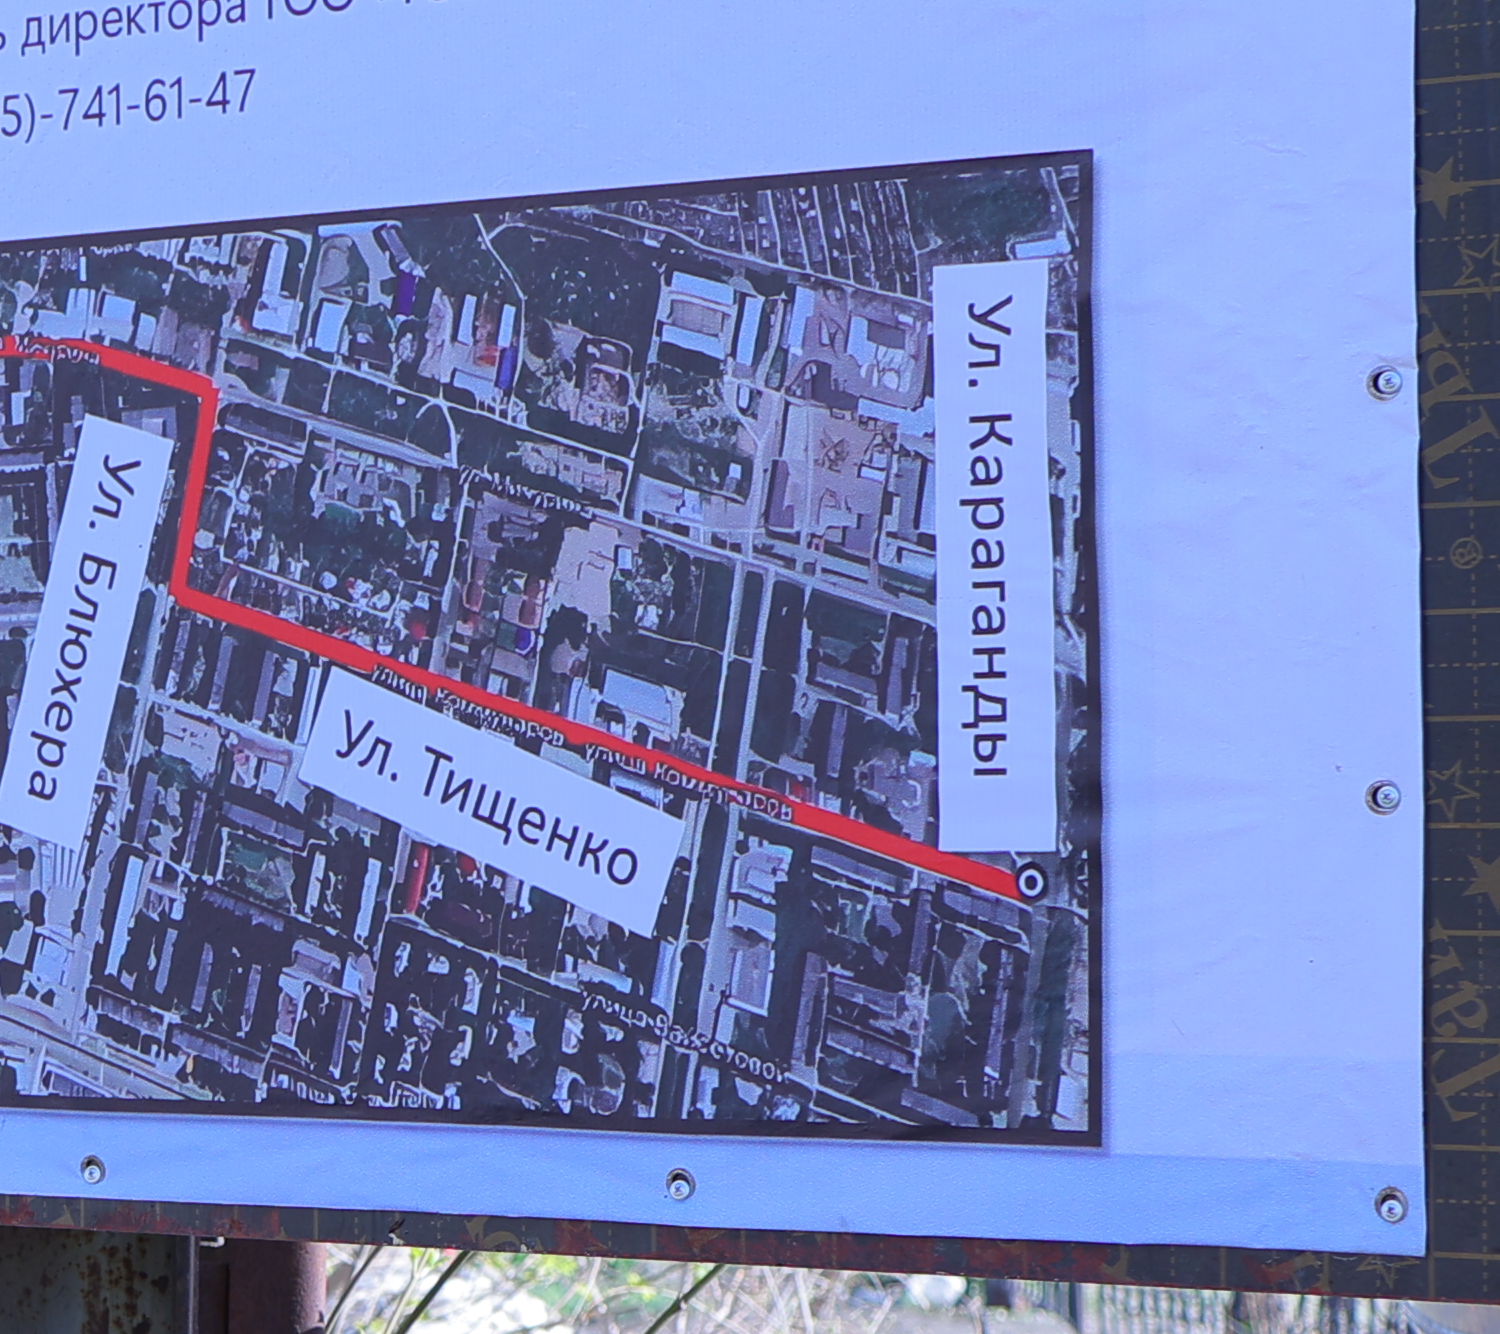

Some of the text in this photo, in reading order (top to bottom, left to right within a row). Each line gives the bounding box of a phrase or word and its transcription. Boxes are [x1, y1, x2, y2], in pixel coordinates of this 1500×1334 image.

[28, 454, 142, 801] Ул. Блюхера
[959, 294, 1013, 776] Ул. Караганды
[336, 709, 398, 782] Ул.
[424, 745, 638, 885] Тищенко
